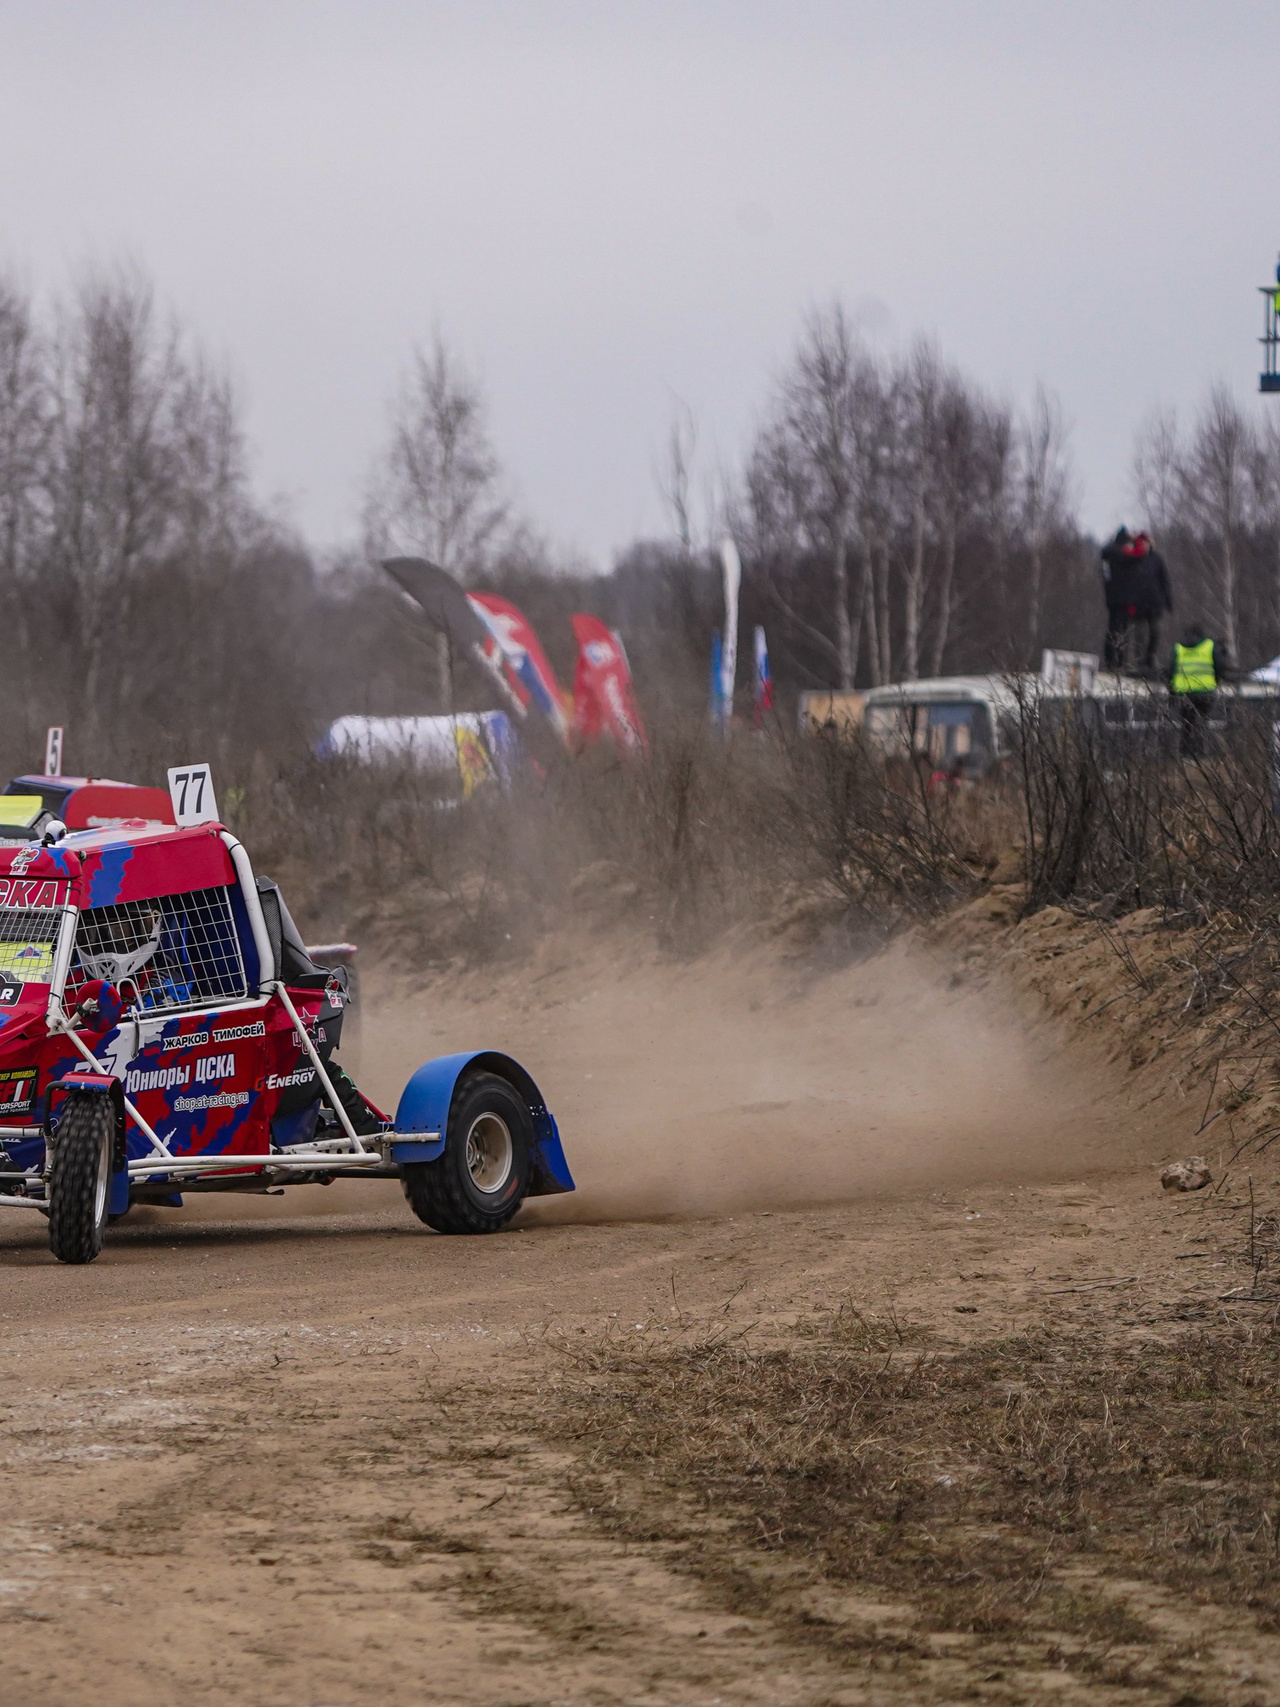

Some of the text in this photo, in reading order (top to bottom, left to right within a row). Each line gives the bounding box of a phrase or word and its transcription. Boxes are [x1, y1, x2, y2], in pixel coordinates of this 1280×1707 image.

[50, 730, 59, 775] 5
[175, 771, 206, 816] 77
[164, 1021, 265, 1050] ЖАРКОВ ТИМОФЕЙ
[126, 1065, 190, 1093] Юниоры
[195, 1053, 236, 1084] ЦСКА
[174, 1092, 250, 1112] shop.at-racing.ru
